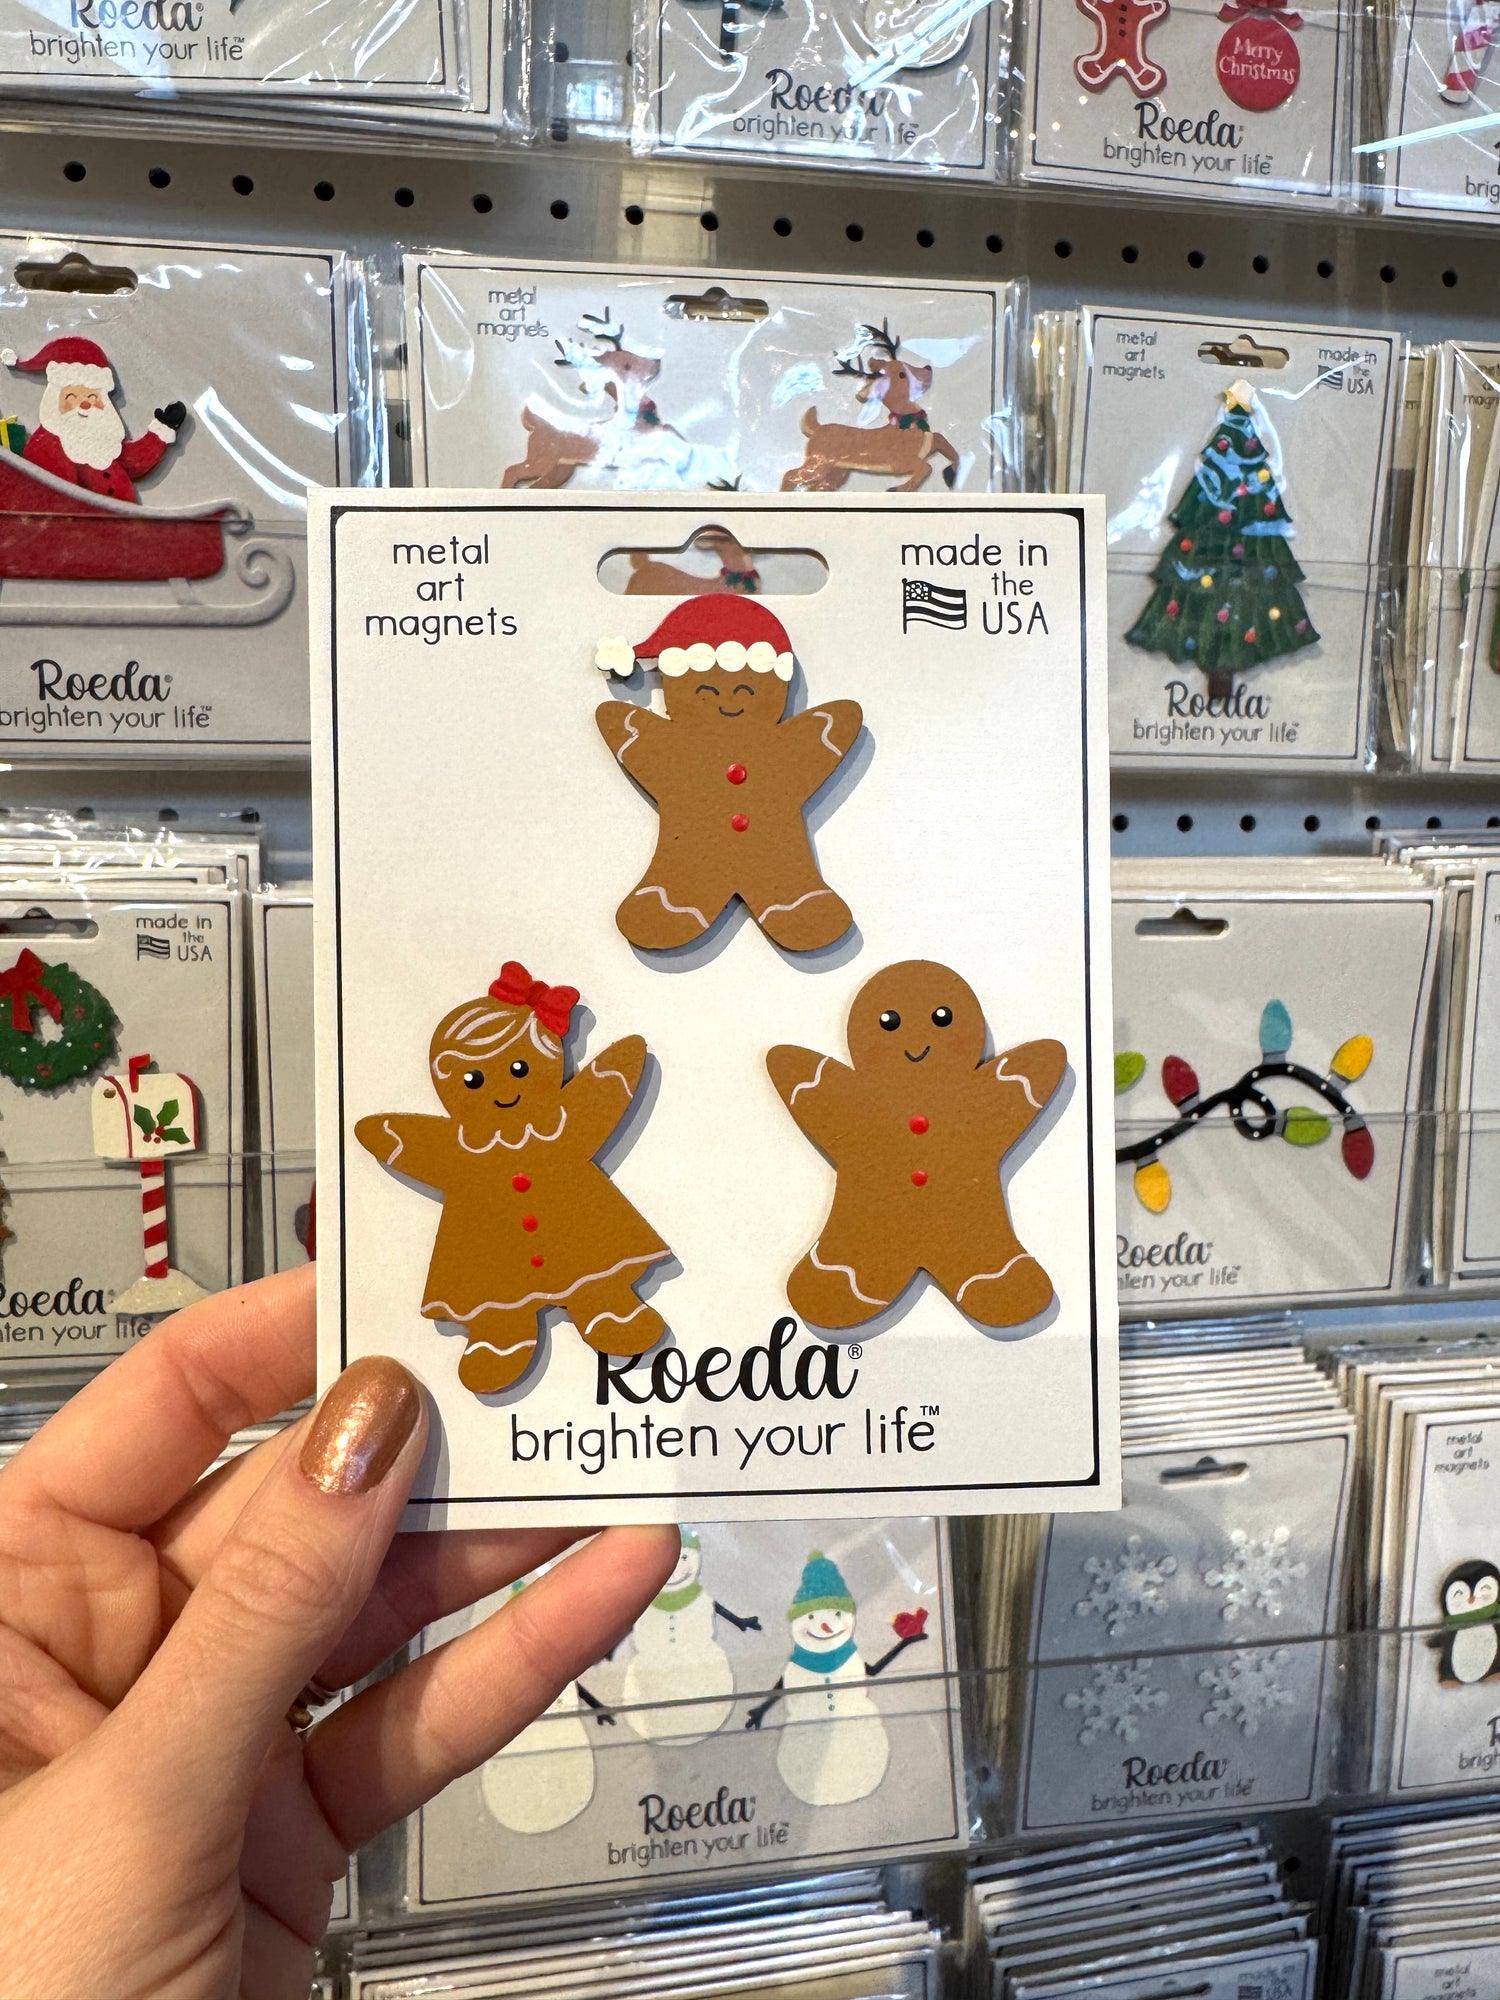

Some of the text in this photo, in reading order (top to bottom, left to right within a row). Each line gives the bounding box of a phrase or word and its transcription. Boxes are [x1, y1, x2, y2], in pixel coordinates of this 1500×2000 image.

[29, 30, 137, 65] brighten
[142, 42, 199, 66] your
[1233, 36, 1284, 66] Merry
[1218, 55, 1297, 85] Christmas
[1103, 136, 1186, 168] brighten
[1191, 154, 1237, 174] your
[488, 285, 537, 305] metal
[499, 305, 525, 322] art
[477, 320, 549, 342] magnets
[1116, 330, 1157, 346] metal
[1124, 348, 1146, 362] art
[1318, 346, 1360, 362] made
[1102, 364, 1166, 382] magnets
[1347, 377, 1375, 395] USA
[393, 533, 489, 565] metal
[901, 533, 1048, 567] made in
[416, 572, 465, 602] art
[991, 570, 1034, 596] the
[365, 606, 518, 645] magnets
[982, 601, 1049, 635] USA
[0, 703, 103, 734] brighten
[109, 711, 166, 734] your
[1133, 717, 1214, 746] brighten
[1219, 727, 1263, 746] your
[136, 912, 212, 929] made in
[183, 930, 205, 944] the
[177, 944, 213, 962] USA
[1160, 1272, 1203, 1293] your
[51, 1323, 108, 1347] your
[511, 1411, 718, 1475] brighten
[734, 1422, 846, 1471] your
[608, 1838, 698, 1868] brighten
[701, 1832, 750, 1859] your
